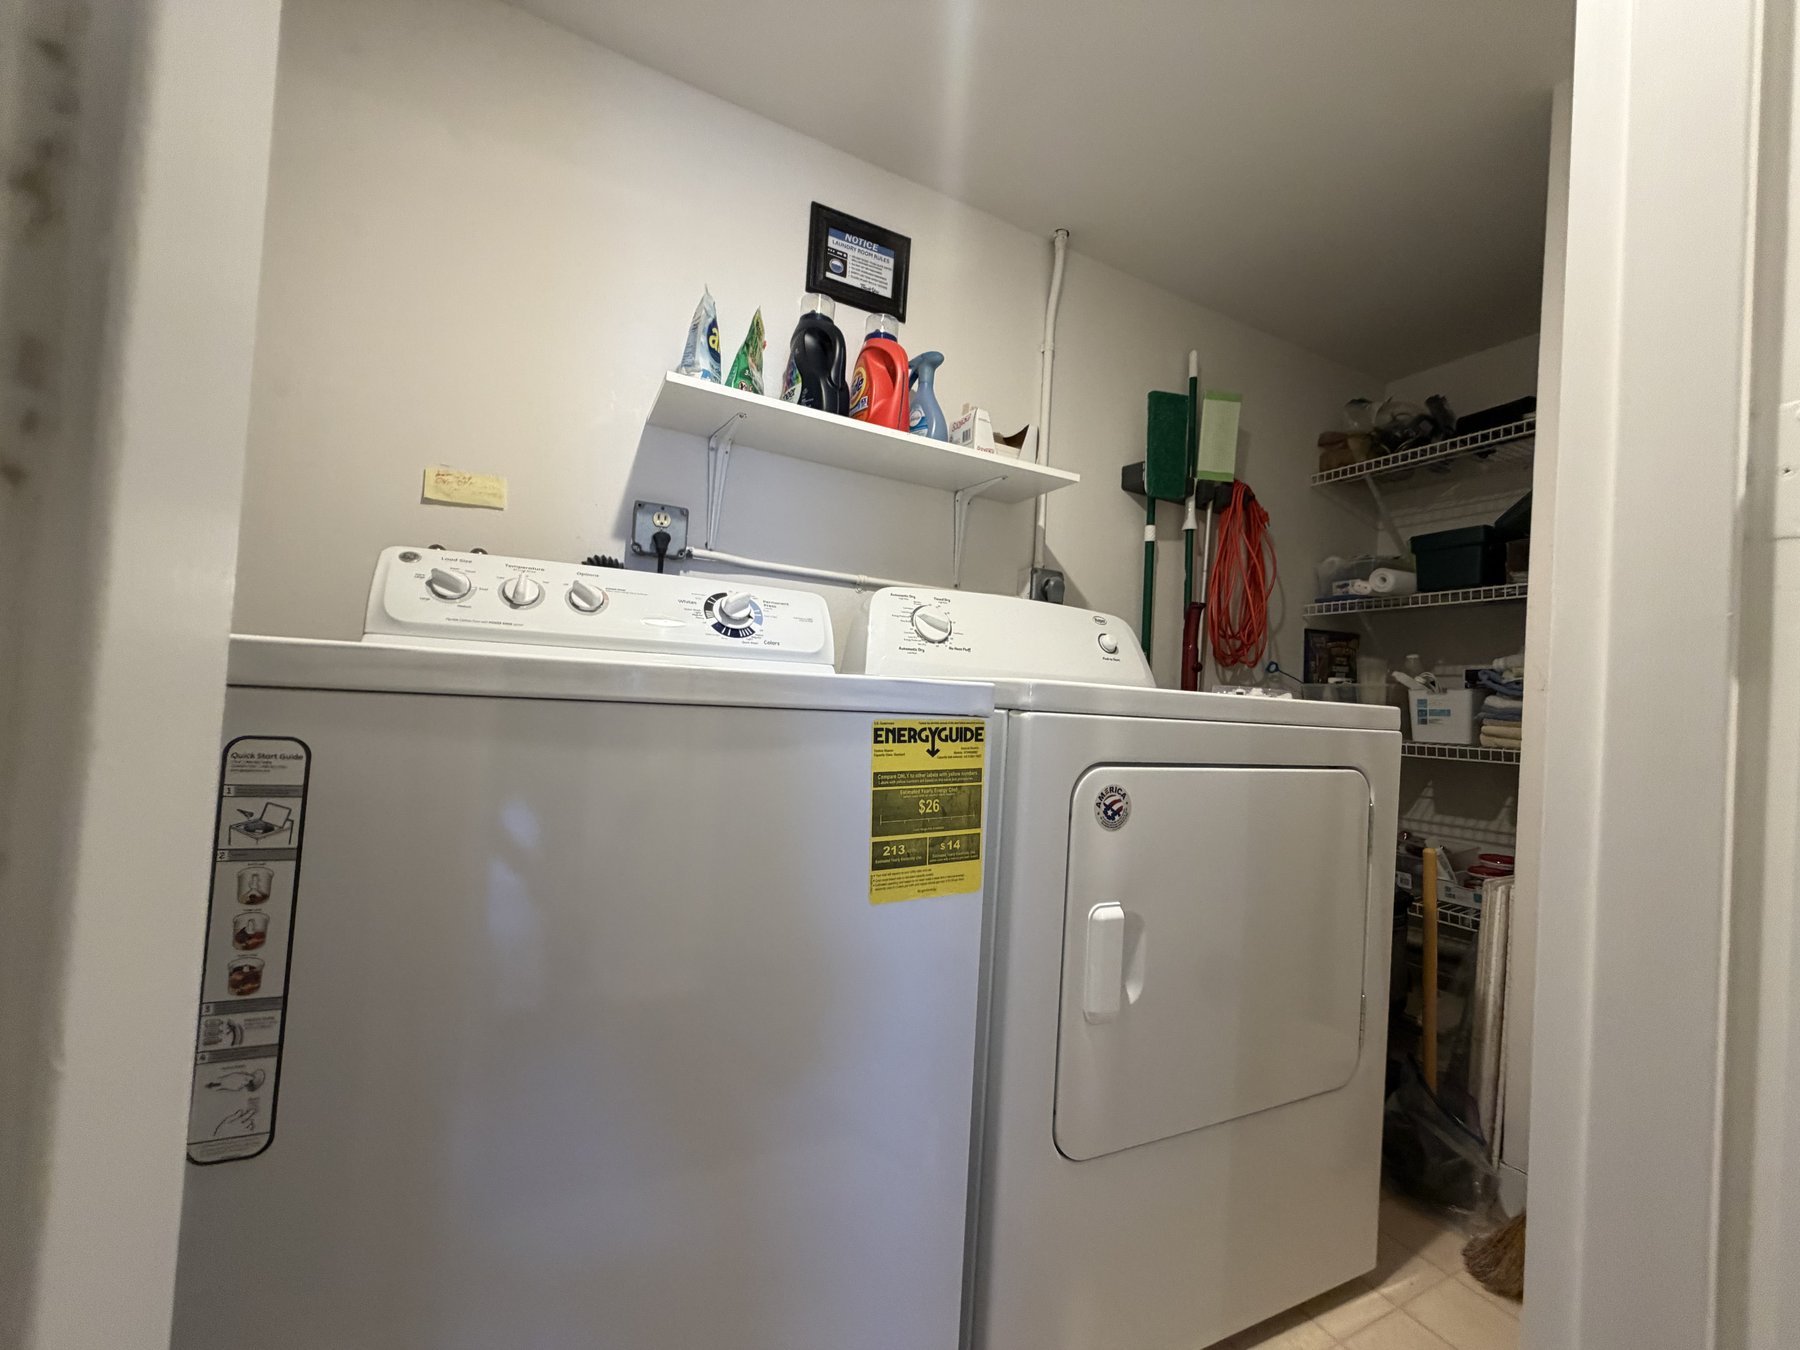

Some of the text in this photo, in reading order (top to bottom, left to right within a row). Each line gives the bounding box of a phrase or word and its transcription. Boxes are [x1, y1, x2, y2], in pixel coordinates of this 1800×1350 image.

[844, 233, 880, 252] NOTICE
[832, 239, 890, 264] LAUNDRY ROOM RULES
[505, 563, 545, 572] Temperature
[873, 726, 985, 744] ENERGYGUIDE
[230, 751, 256, 760] Quick
[257, 752, 278, 760] Start
[1095, 786, 1127, 809] AMERICA
[918, 798, 940, 815] $26
[882, 844, 906, 856] 213
